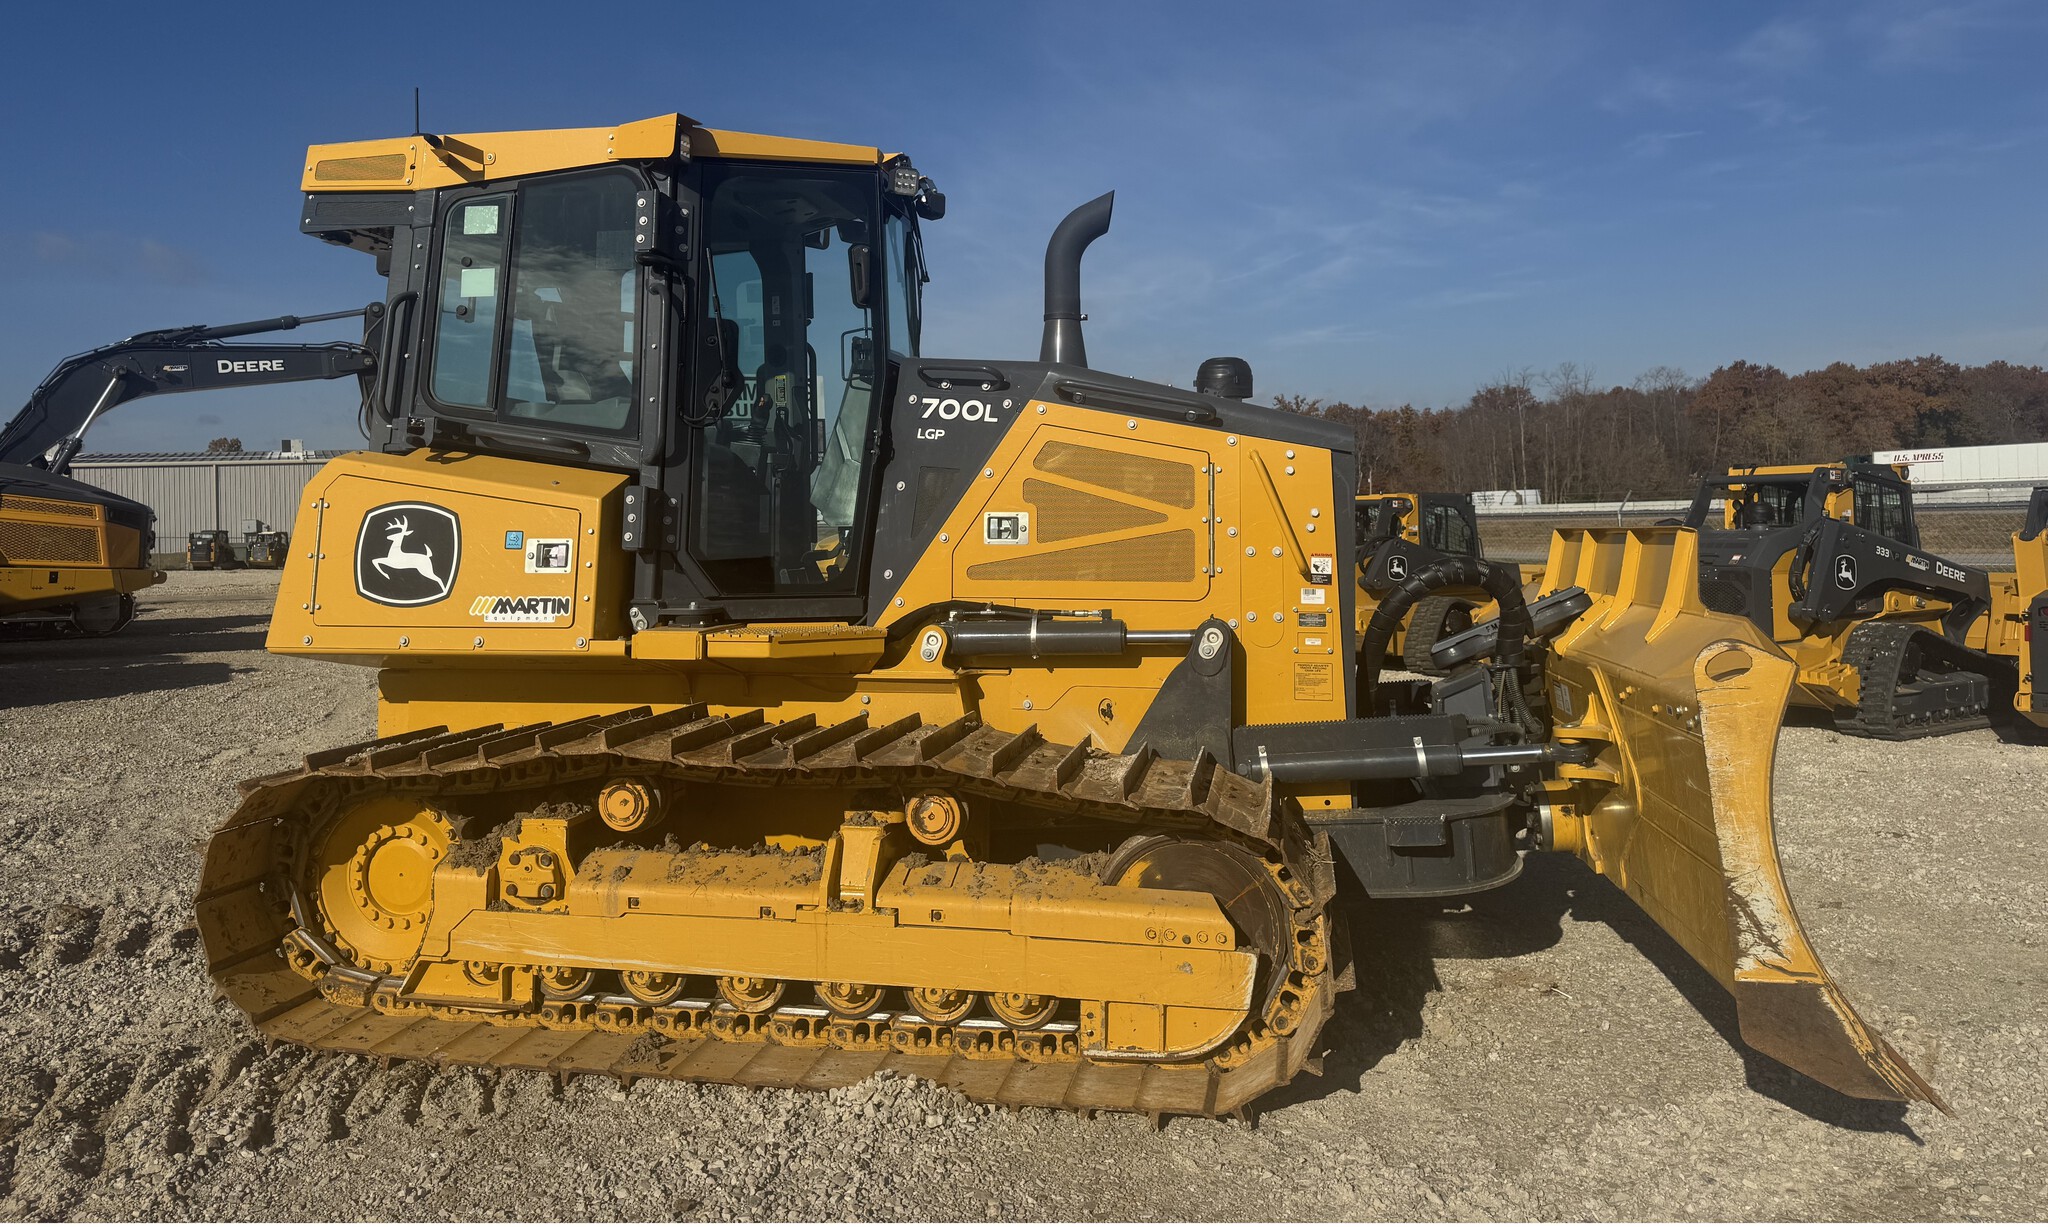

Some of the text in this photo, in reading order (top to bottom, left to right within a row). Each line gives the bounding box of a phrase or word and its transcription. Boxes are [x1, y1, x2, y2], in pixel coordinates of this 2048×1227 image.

[217, 360, 285, 373] DEERE
[921, 397, 998, 422] 700L
[917, 428, 945, 440] LGP
[1875, 545, 1890, 558] 333
[1936, 561, 1966, 583] DEERE
[490, 598, 570, 615] MARTIN
